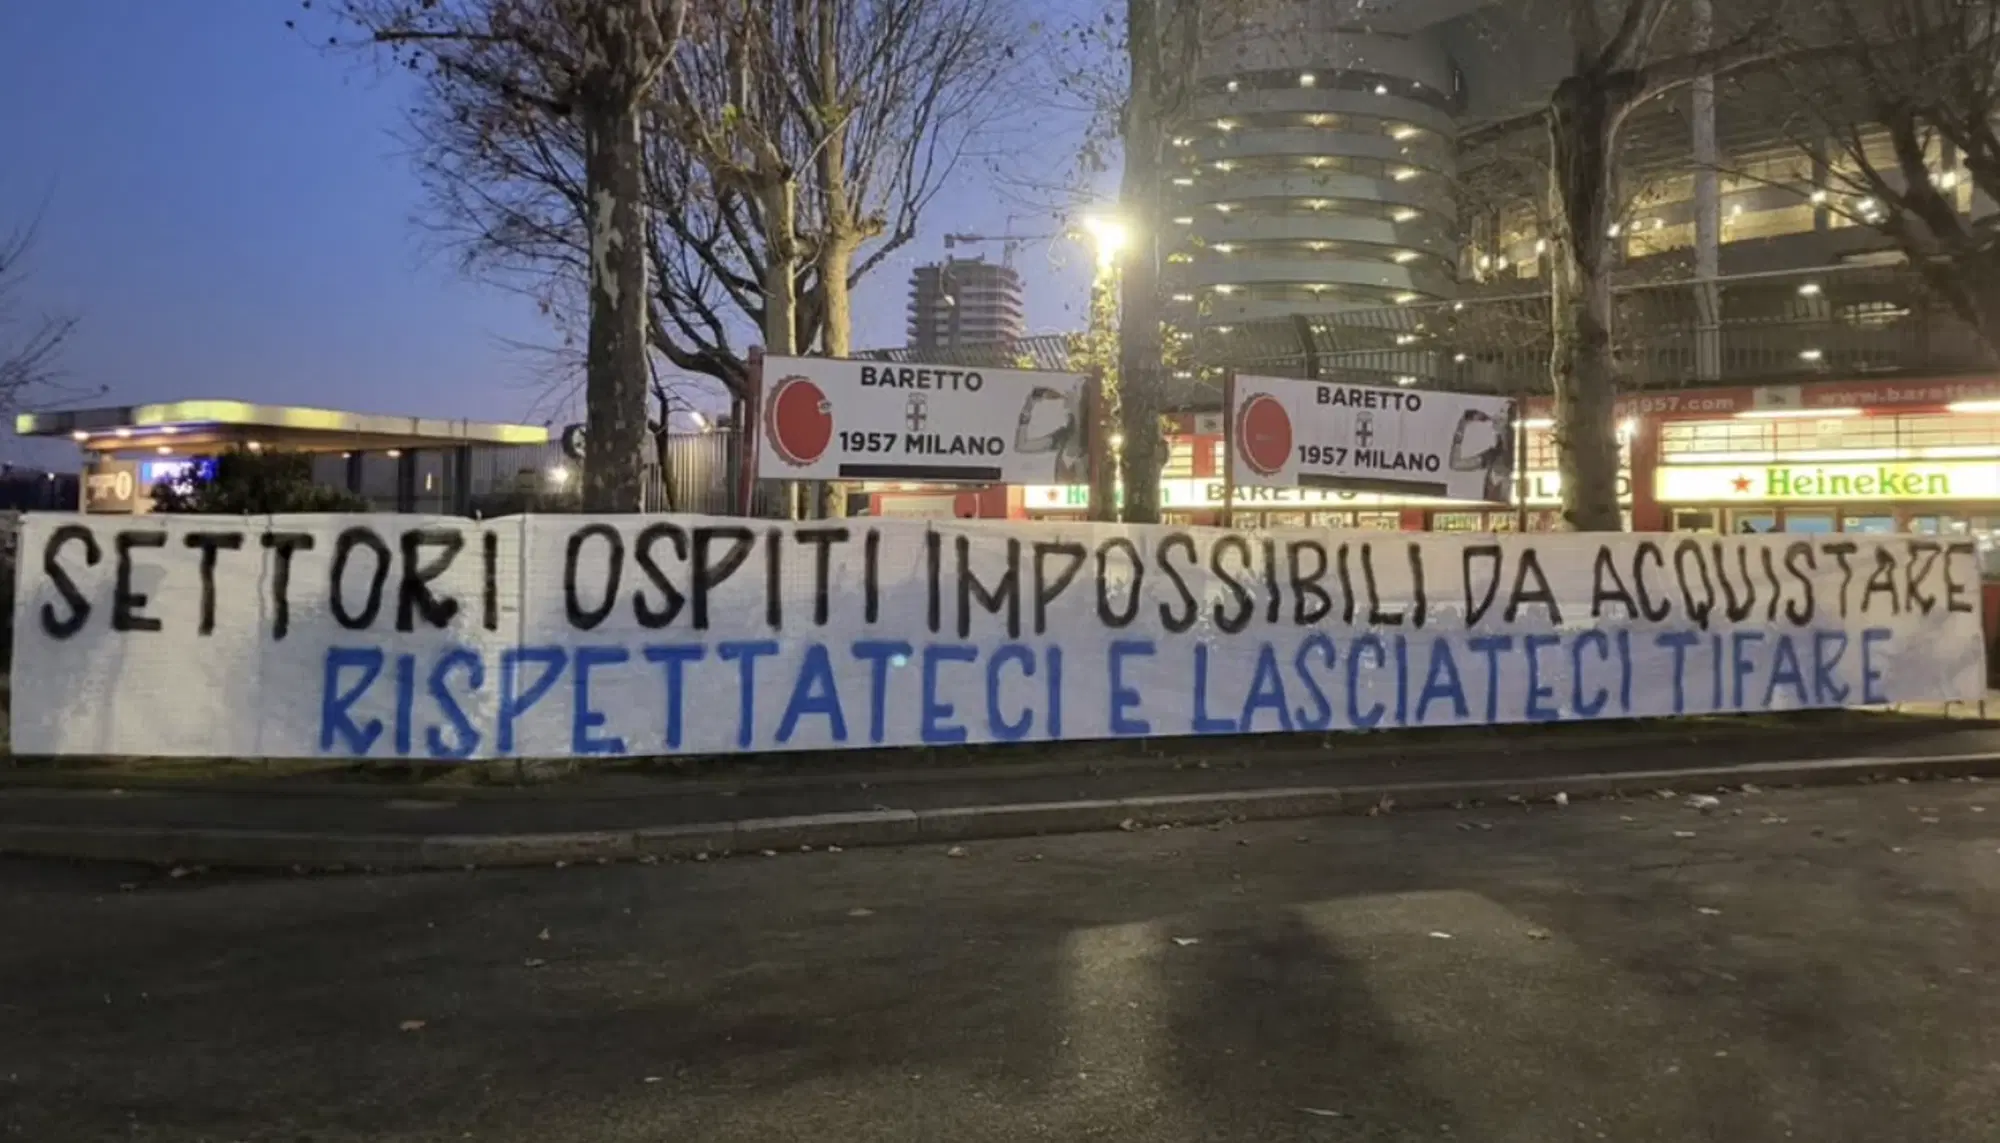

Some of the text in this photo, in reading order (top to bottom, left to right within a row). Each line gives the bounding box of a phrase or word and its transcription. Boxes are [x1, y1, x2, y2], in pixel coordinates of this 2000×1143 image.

[860, 366, 984, 392] BARETTO
[1316, 386, 1422, 412] BARETTO
[839, 432, 1005, 456] 1957 MILANO
[1298, 445, 1441, 472] 1957 MILANO
[1766, 467, 1951, 497] Heineken
[41, 523, 1974, 640] SETTORI OSPITI IMPOSSIBILI DA ACQUISTARE
[318, 628, 1893, 758] RISPETTATECI E LASCIATECI TIFARE
